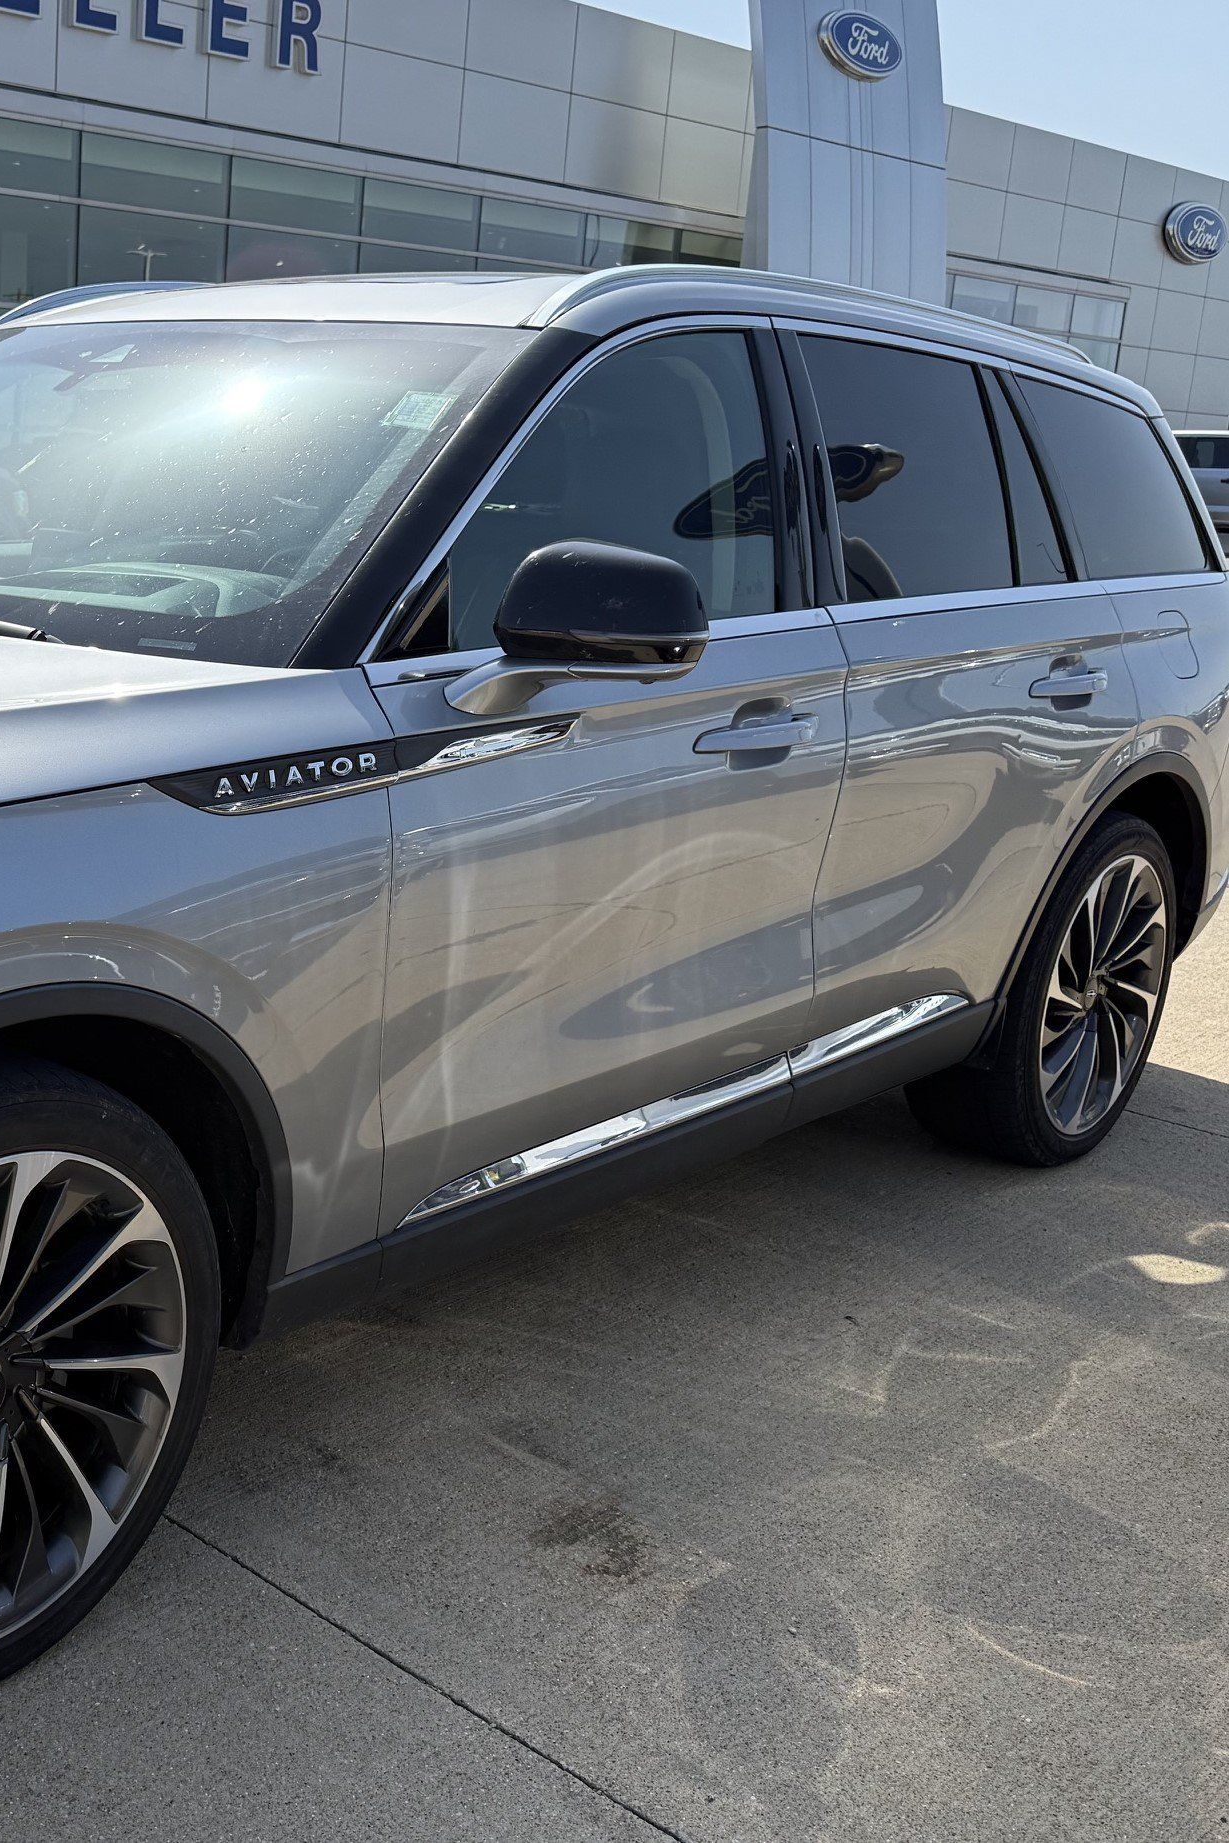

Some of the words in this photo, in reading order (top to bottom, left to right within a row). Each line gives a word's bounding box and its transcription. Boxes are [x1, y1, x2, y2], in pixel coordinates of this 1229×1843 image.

[847, 22, 889, 65] Ford
[1187, 215, 1221, 251] Ford
[214, 752, 377, 799] AVIATOR
